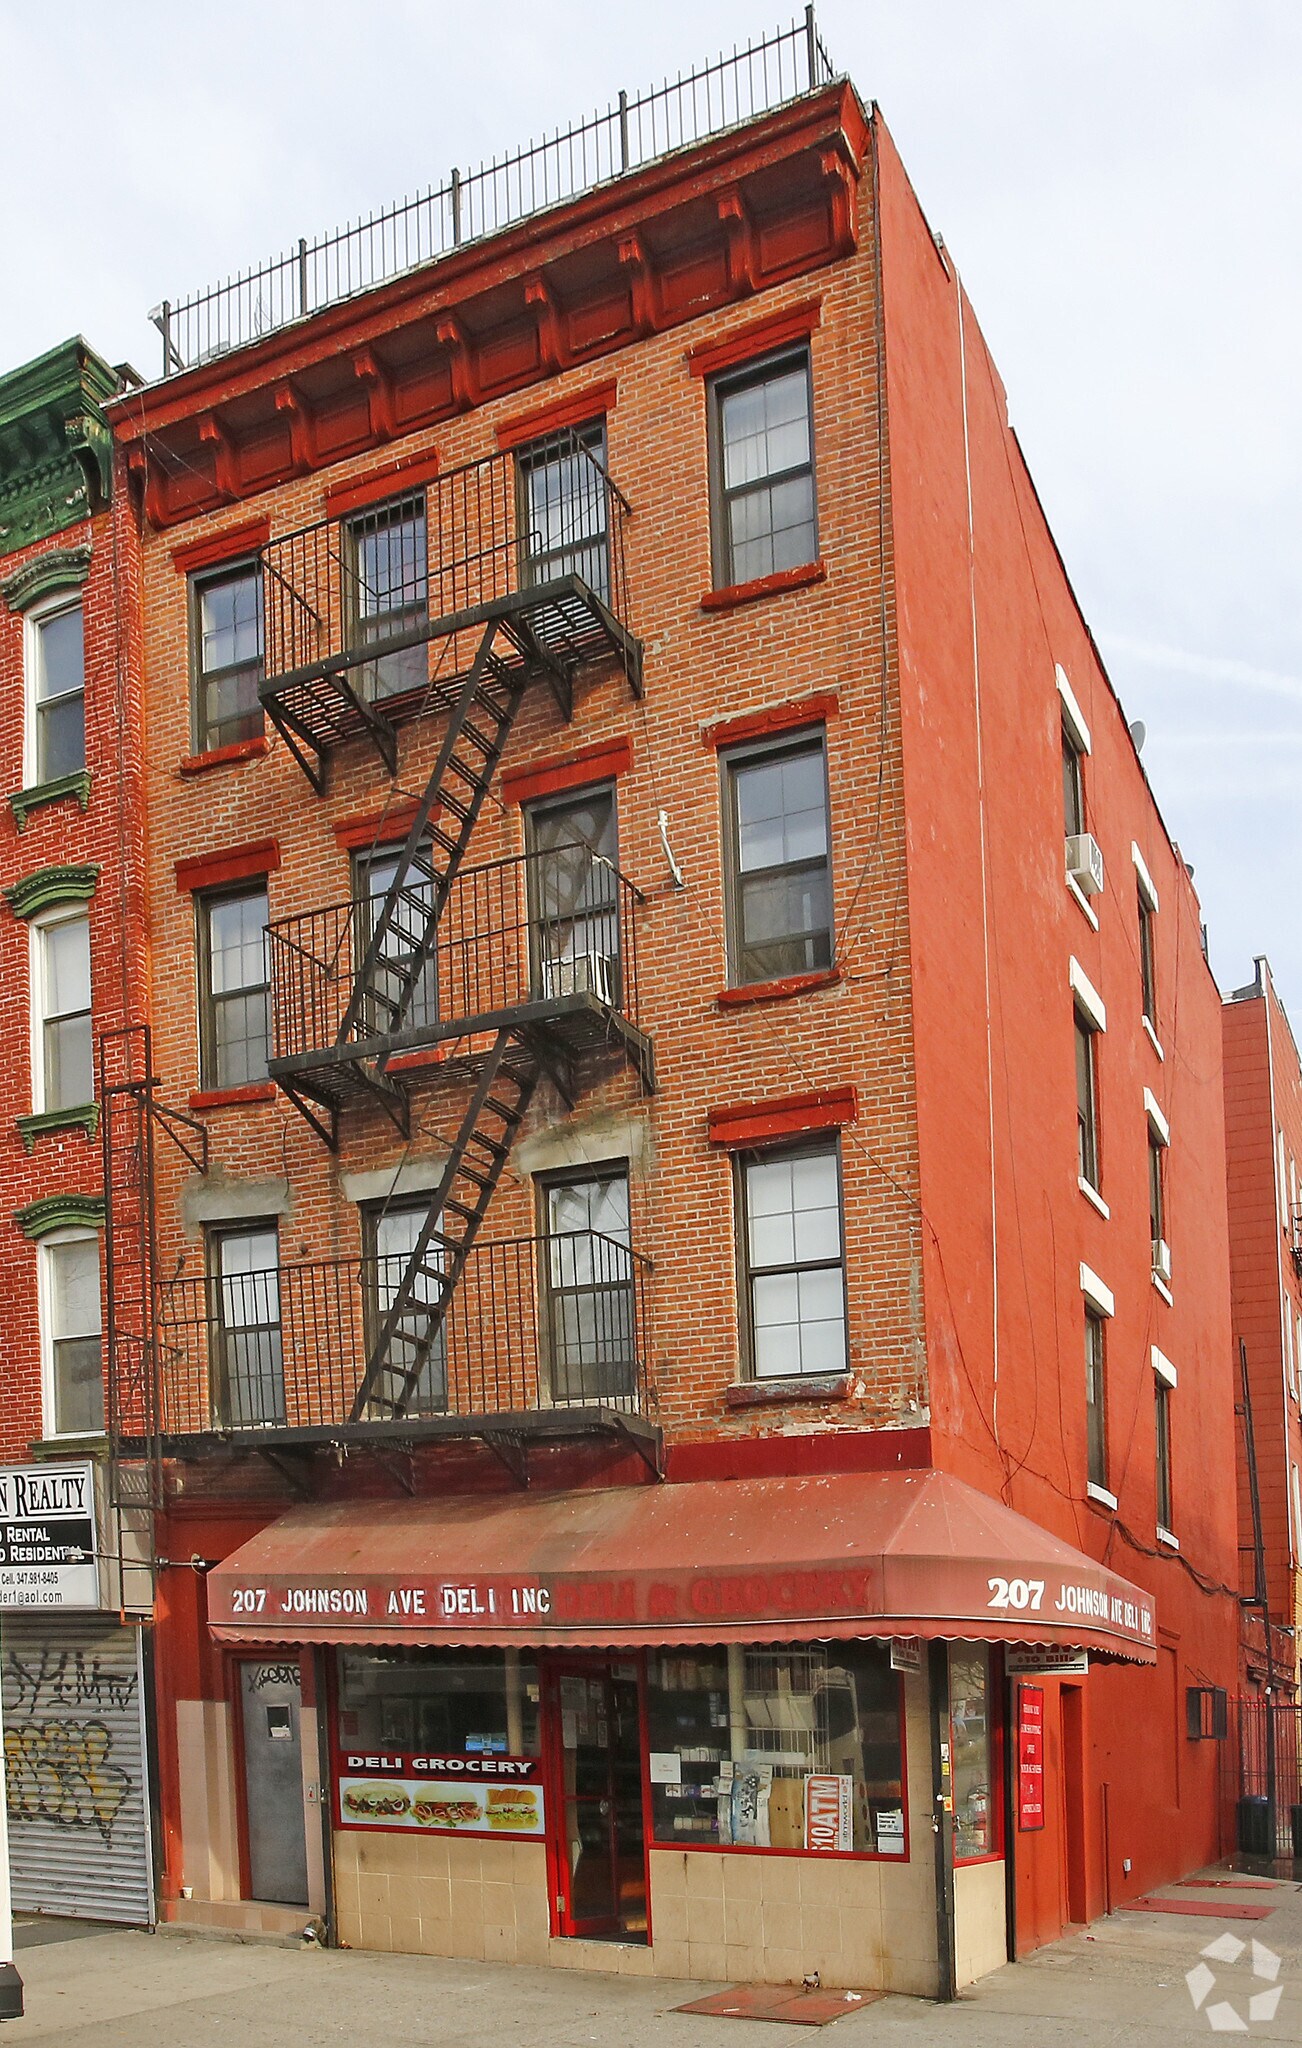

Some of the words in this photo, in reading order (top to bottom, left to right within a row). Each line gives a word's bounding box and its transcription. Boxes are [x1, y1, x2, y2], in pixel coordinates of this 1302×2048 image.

[12, 1475, 85, 1517] REALTY
[6, 1526, 51, 1543] RENTAL
[10, 1544, 85, 1562] RESIDENTL
[232, 1588, 267, 1613] 207
[281, 1588, 369, 1615] JOHNSON
[387, 1589, 426, 1614] AVE
[443, 1588, 496, 1614] DELI
[511, 1587, 551, 1614] INC
[987, 1577, 1046, 1611] 207
[1054, 1584, 1109, 1619] JOHNSON
[1110, 1596, 1123, 1626] AVE
[1124, 1602, 1139, 1631] DELI
[347, 1756, 402, 1769] DELI
[411, 1758, 532, 1774] GROCERY
[811, 1780, 838, 1830] ATM
